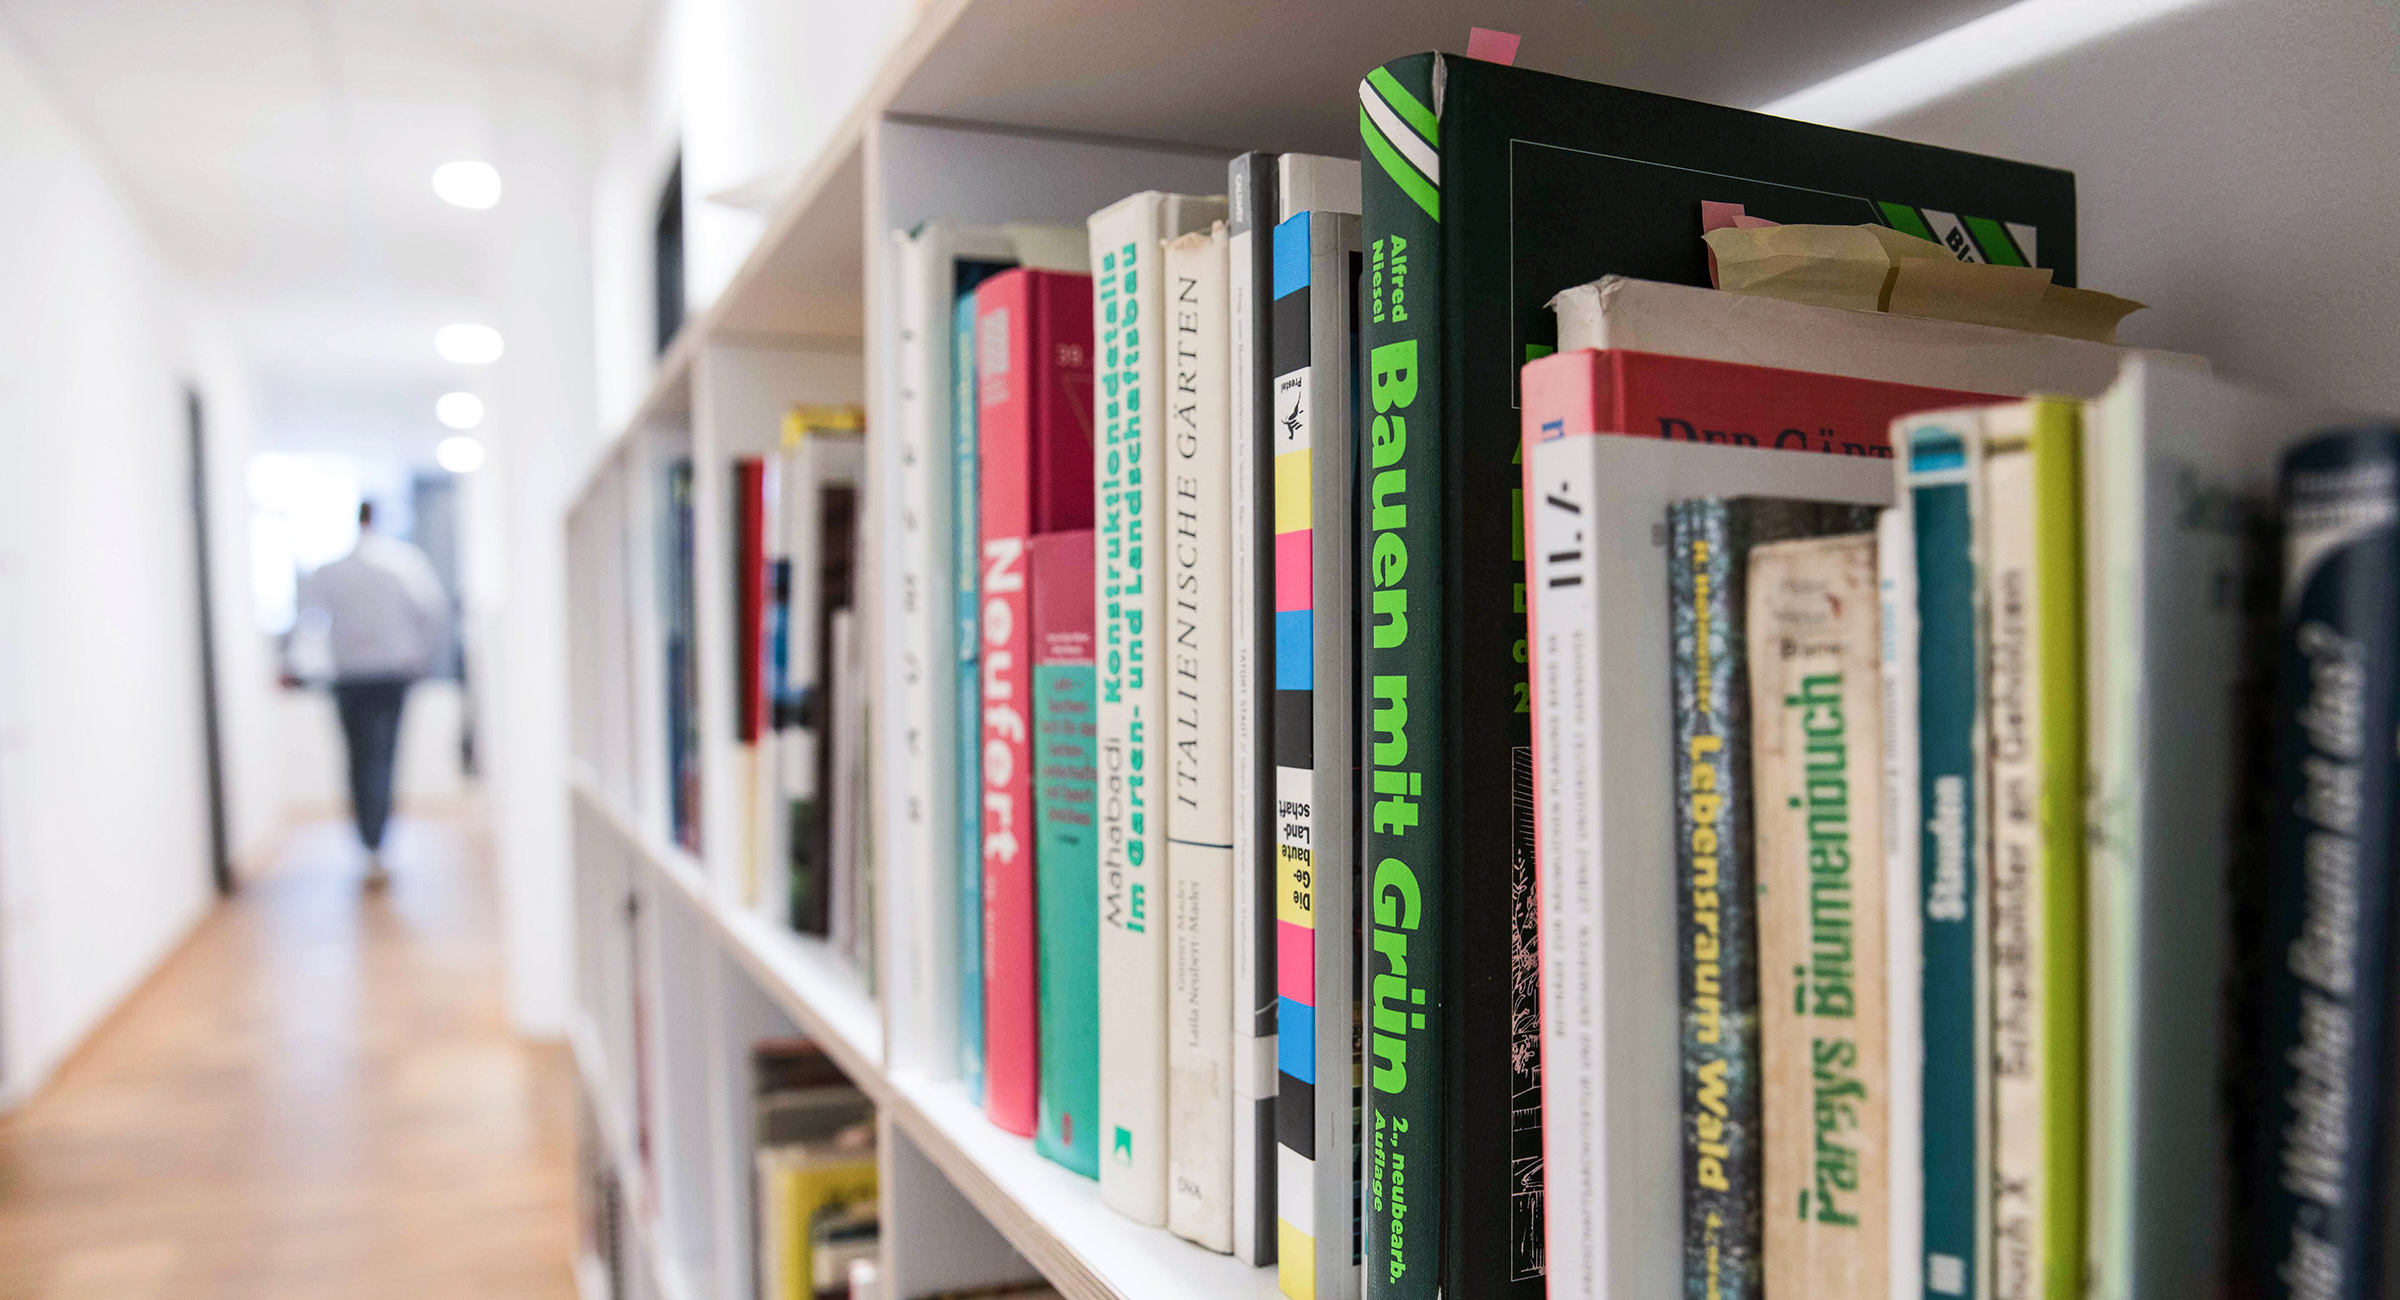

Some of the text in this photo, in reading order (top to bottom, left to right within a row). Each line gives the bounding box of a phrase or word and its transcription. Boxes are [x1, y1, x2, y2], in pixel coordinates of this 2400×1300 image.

[1372, 239, 1385, 324] Niesel
[1391, 234, 1408, 323] Alfred
[1121, 241, 1143, 596] Landschaftsbau
[1280, 376, 1302, 393] Prestel
[1174, 276, 1198, 808] ITALIENISCHE GÄRTEN
[1100, 252, 1123, 929] Mahabadi Konstruktionsdetails
[1125, 609, 1143, 689] und
[983, 536, 1025, 863] Neufert
[1371, 339, 1426, 1094] Bauen mit Grün
[1127, 706, 1145, 868] Garten-
[1279, 800, 1310, 820] schaft
[1283, 823, 1310, 844] Land-
[1281, 844, 1310, 866] baute
[1293, 869, 1311, 888] Ge-
[1293, 891, 1311, 911] Die
[1689, 734, 1730, 1192] Lebensraum Wald
[1373, 1108, 1386, 1212] Auflage
[1390, 1115, 1408, 1284] 2., neubearb.
